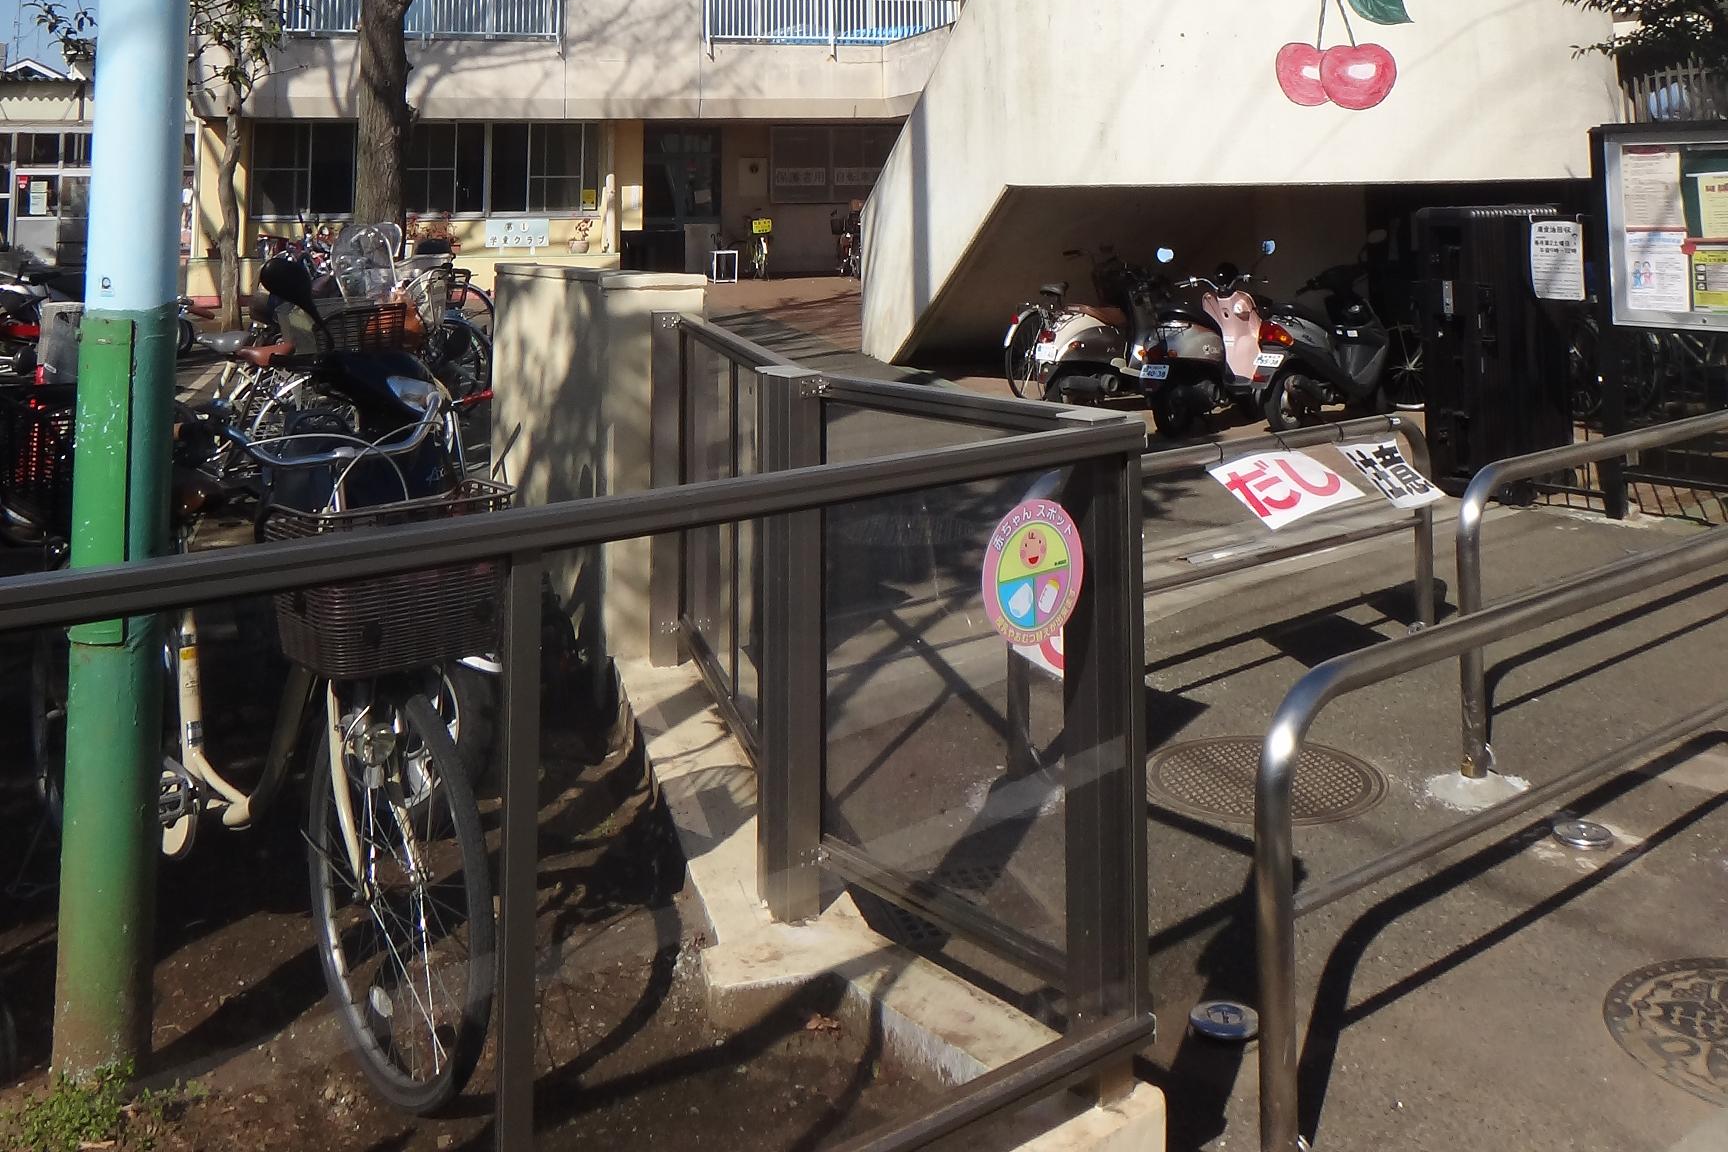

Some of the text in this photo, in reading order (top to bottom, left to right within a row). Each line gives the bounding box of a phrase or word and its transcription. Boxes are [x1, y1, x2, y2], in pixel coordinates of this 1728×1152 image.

[489, 236, 545, 246] 学童クラブ
[1225, 445, 1434, 517] だし 注意
[992, 504, 1074, 551] 赤ちゃん スポット
